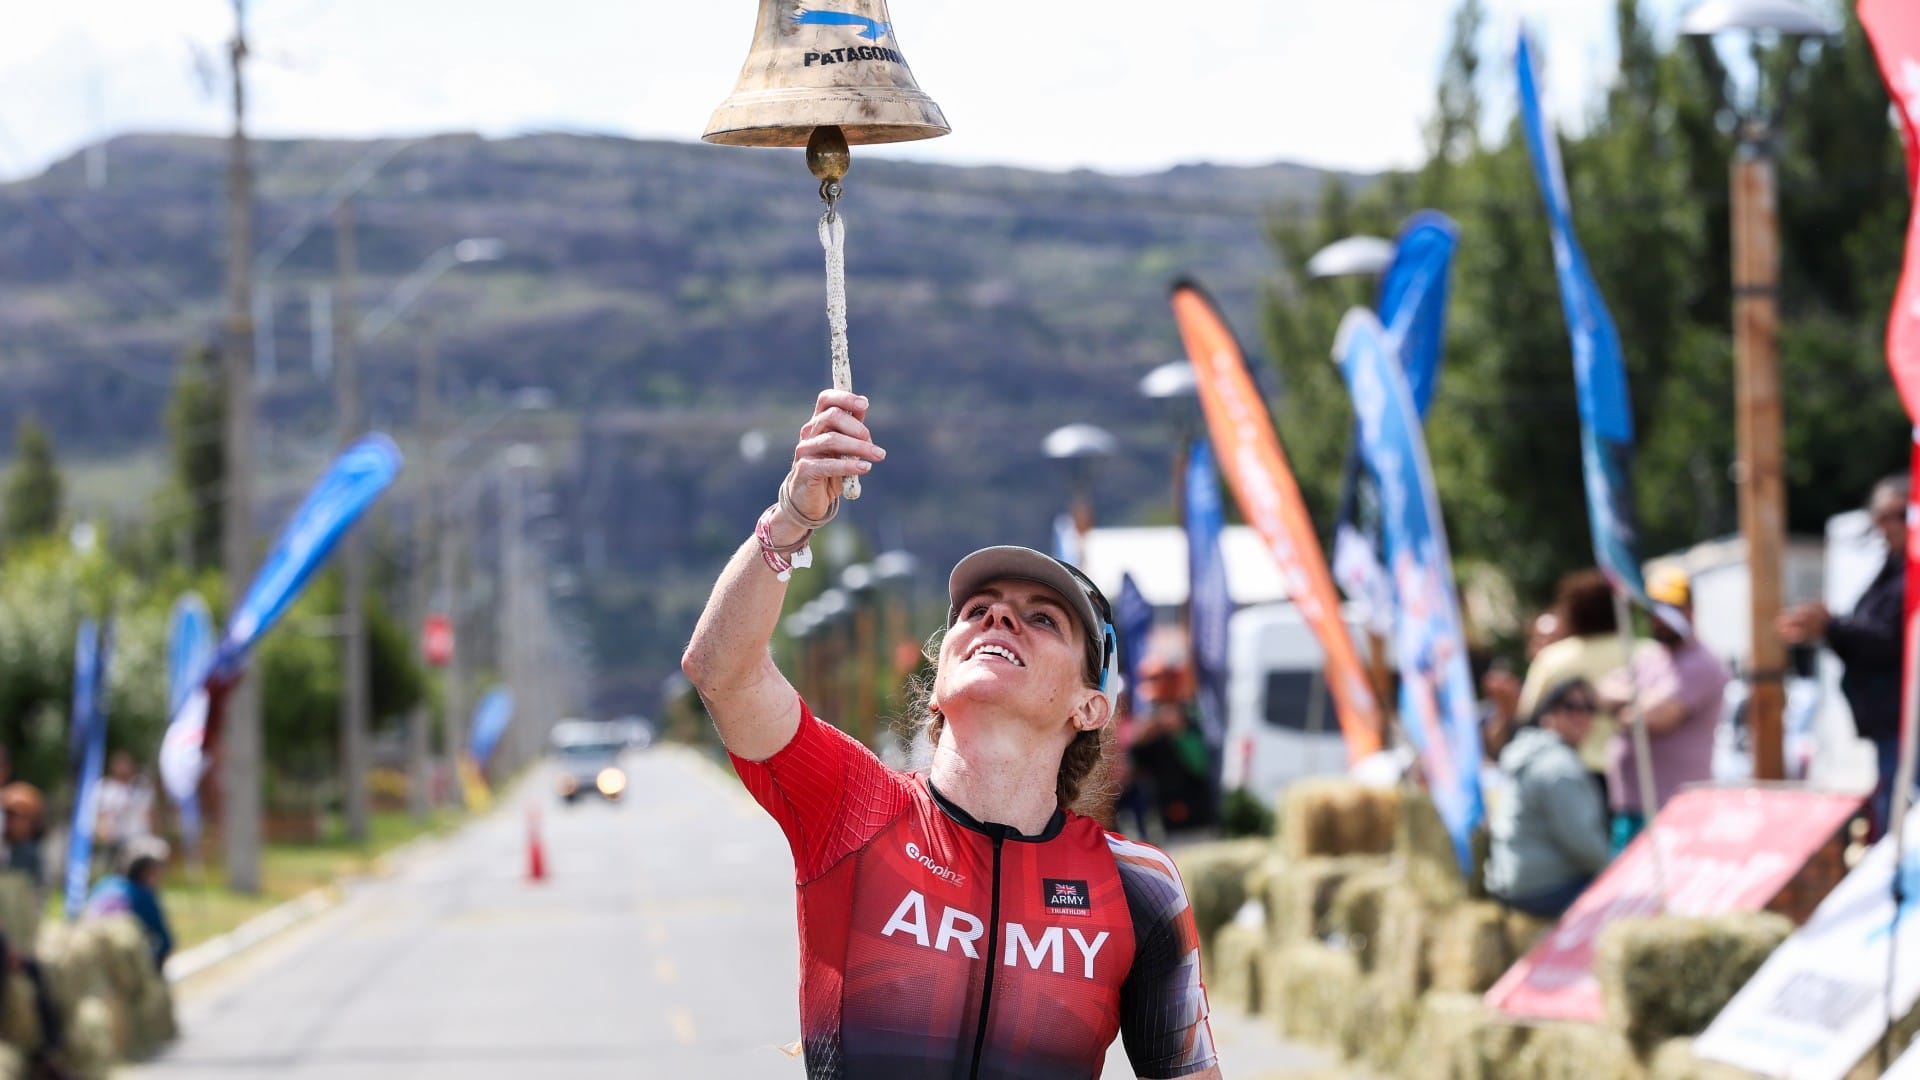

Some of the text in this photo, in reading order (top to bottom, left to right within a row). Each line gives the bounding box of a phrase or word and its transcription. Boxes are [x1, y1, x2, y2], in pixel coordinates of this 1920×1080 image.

[1051, 895, 1084, 905] ARMY
[1051, 908, 1086, 916] TRIATHLON
[881, 889, 1110, 979] ARMY
